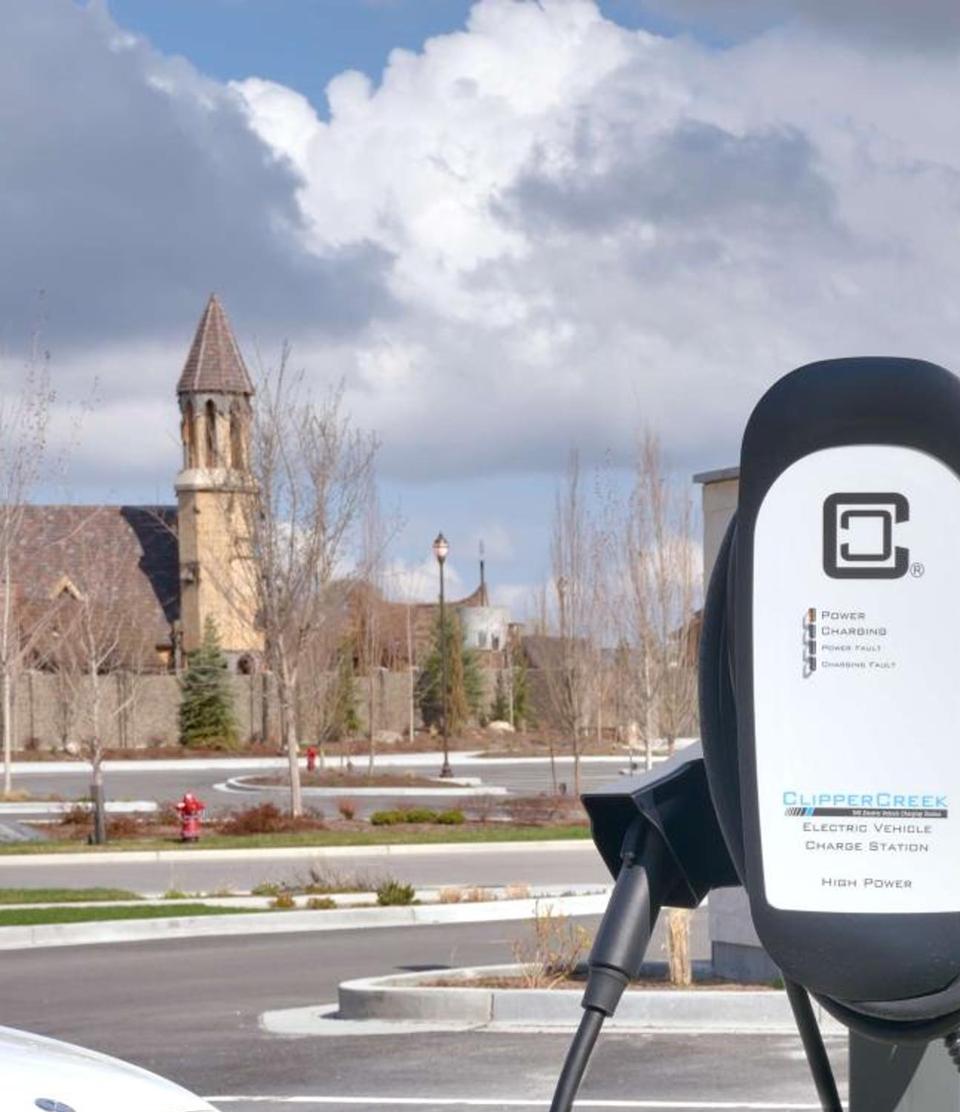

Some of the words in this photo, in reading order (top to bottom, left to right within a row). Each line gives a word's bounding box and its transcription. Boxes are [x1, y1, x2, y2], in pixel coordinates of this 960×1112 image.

[821, 610, 866, 620] POWER
[821, 626, 887, 636] CHARGING
[802, 822, 868, 833] ELECTRIC
[874, 823, 932, 834] VEHICLE
[805, 841, 863, 851] CHARGE
[868, 841, 929, 852] STATION
[821, 877, 857, 887] HIGH
[864, 878, 912, 888] POWER
